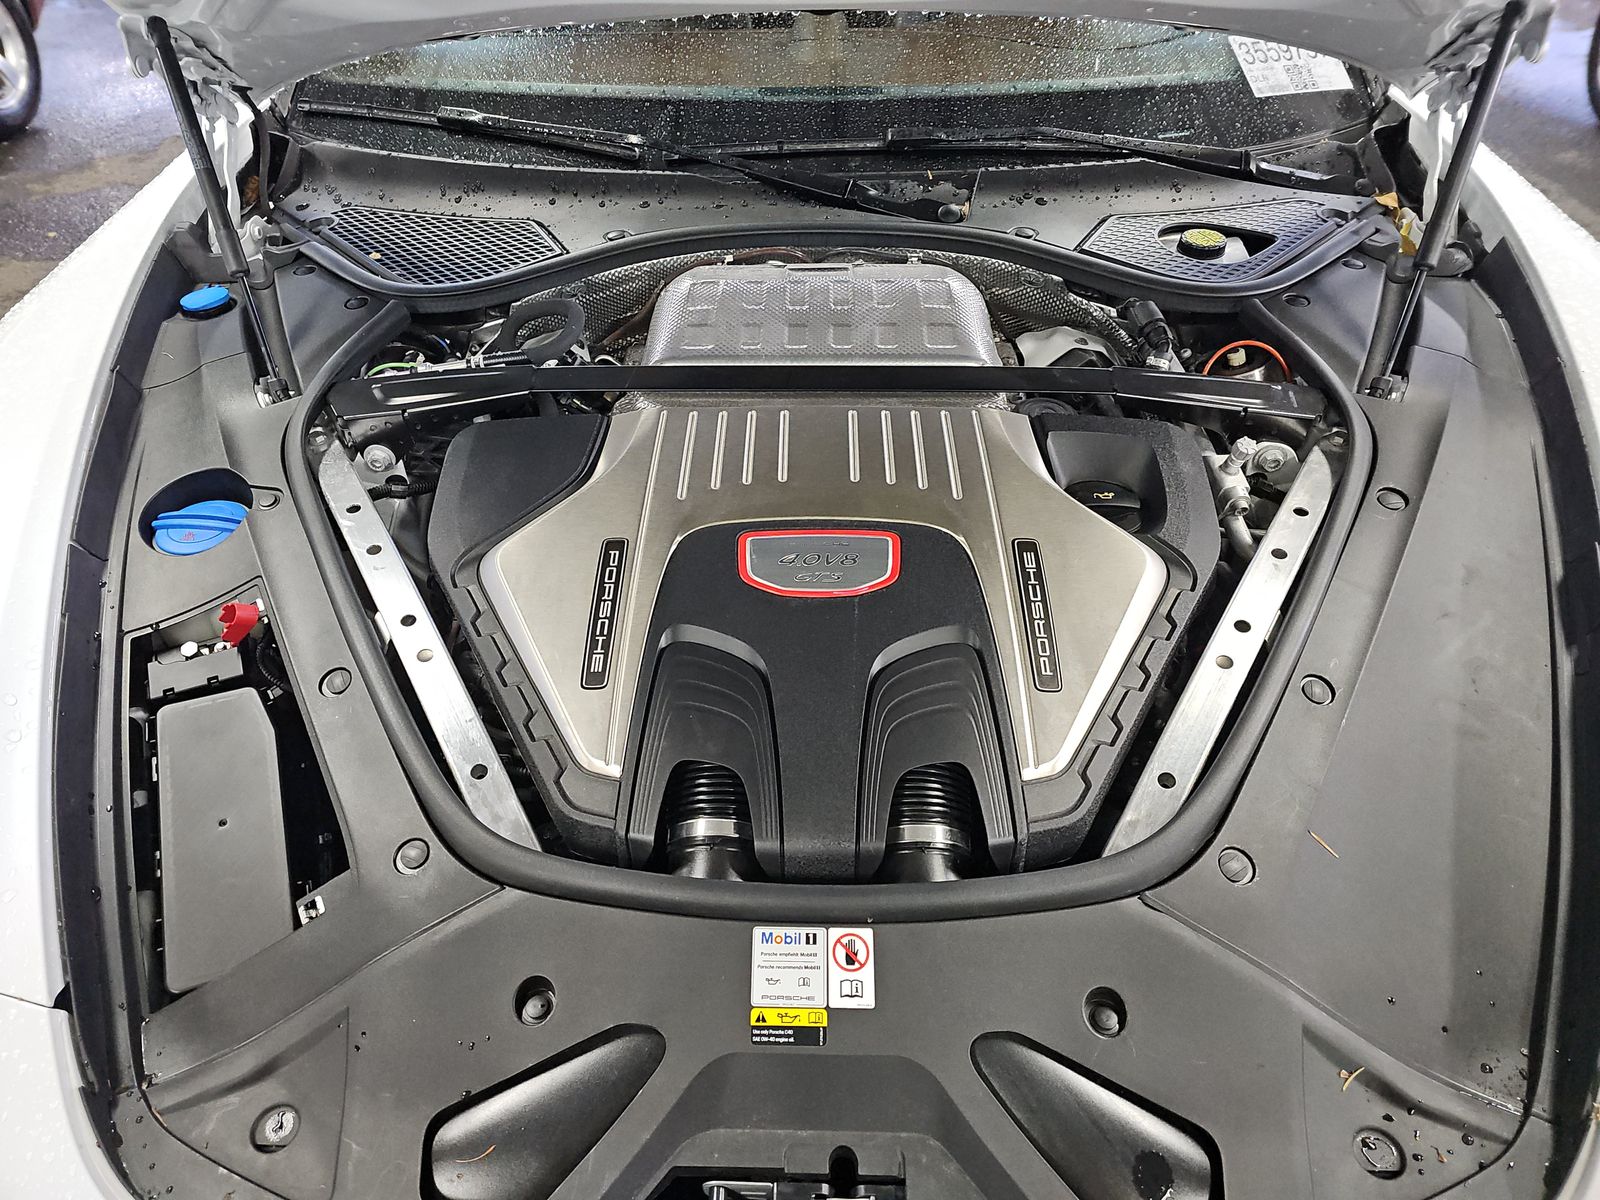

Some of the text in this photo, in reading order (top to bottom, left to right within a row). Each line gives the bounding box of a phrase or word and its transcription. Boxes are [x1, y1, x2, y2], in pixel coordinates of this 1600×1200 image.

[793, 571, 844, 583] GTS
[590, 550, 620, 673] PORSCHE
[1023, 551, 1053, 676] PORSCHE
[761, 931, 818, 945] Mobil 1
